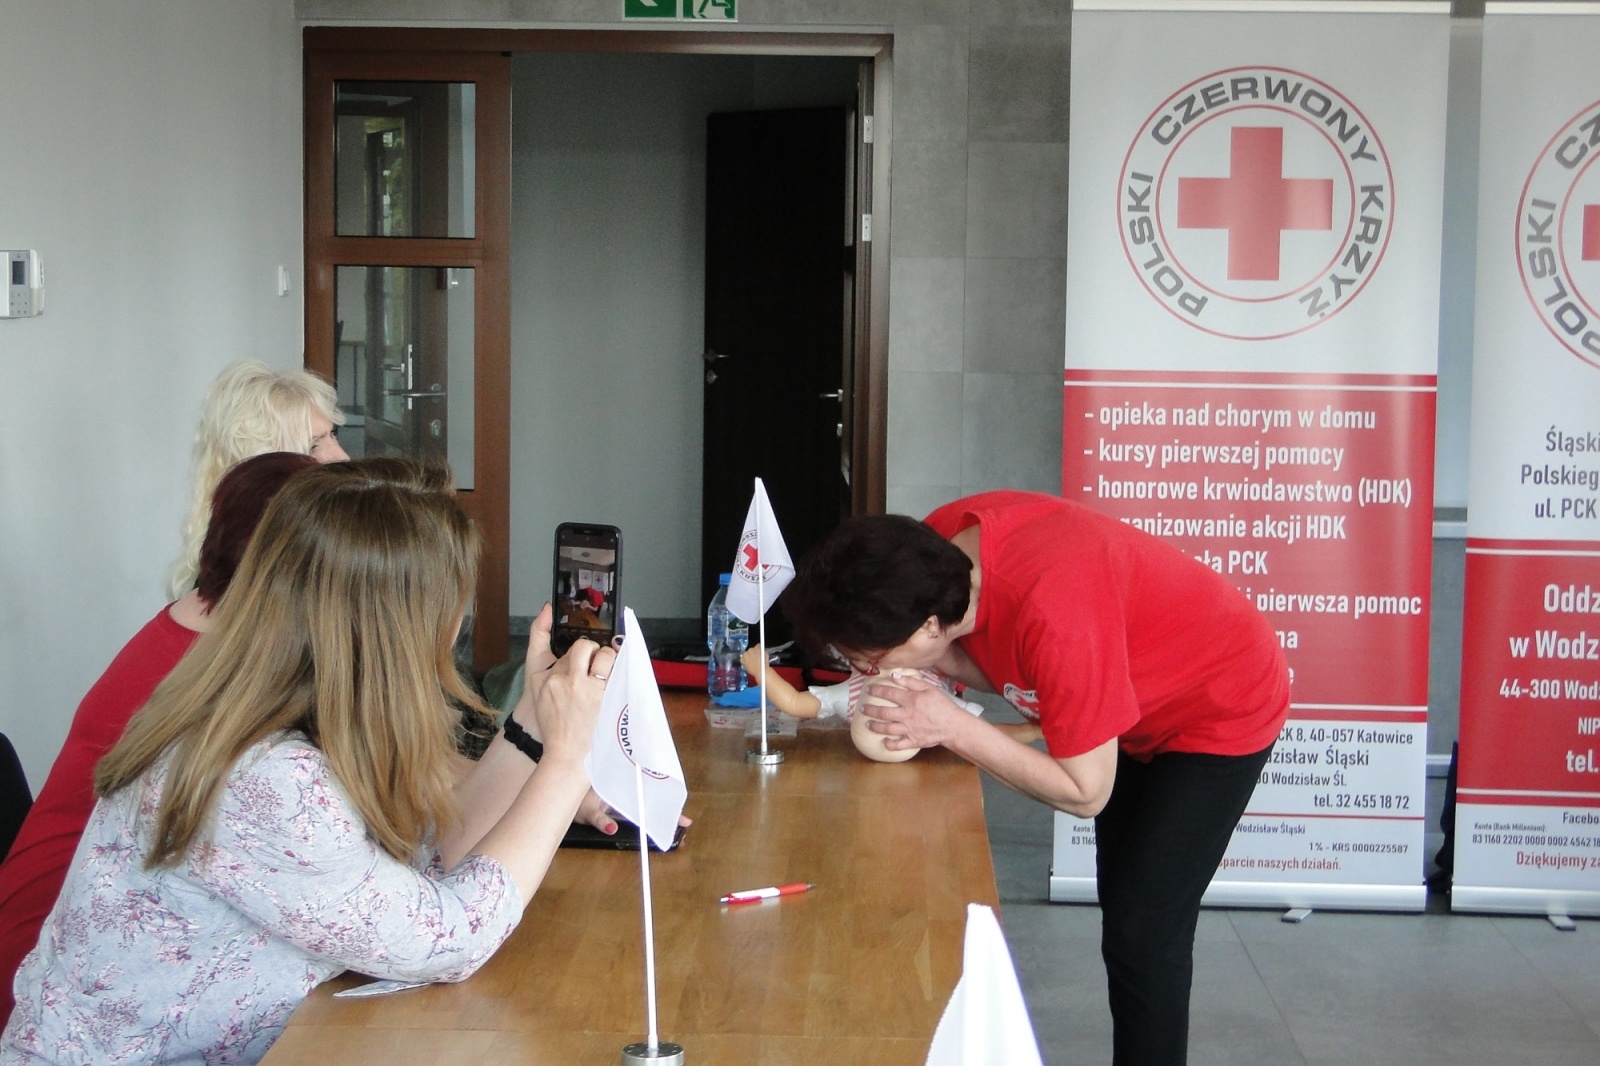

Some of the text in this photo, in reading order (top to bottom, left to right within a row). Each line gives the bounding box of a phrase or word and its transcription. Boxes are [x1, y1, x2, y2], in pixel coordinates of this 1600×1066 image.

[1152, 76, 1378, 163] CZERWONY
[1128, 172, 1208, 318] POLSKI
[1099, 402, 1167, 430] opieka
[1172, 403, 1210, 428] nad
[1214, 403, 1292, 433] chorym
[1297, 408, 1315, 429] w
[1319, 405, 1376, 430] domu
[1098, 438, 1156, 468] kursy
[1161, 440, 1261, 470] pierwszej
[1265, 444, 1345, 471] pomocy
[1520, 464, 1599, 491] Polskieg
[1098, 475, 1198, 500] honorowe
[1203, 477, 1353, 503] krwiodawstwo
[1358, 477, 1412, 508] (HDK)
[1534, 498, 1598, 519] ul. PCK
[1252, 514, 1301, 544] akcji
[1306, 516, 1347, 540] HDK
[1228, 550, 1269, 575] PCK
[1256, 587, 1349, 614] pierwsza
[1354, 594, 1422, 619] pomoc
[1508, 629, 1600, 660] w Wodz
[1499, 678, 1600, 701] 44-300 Wod
[1309, 728, 1354, 743] 40-057
[1357, 729, 1413, 744] Katowice
[1325, 745, 1369, 769] Śląski
[1566, 749, 1599, 773] tel.
[1272, 772, 1330, 786] Wodzisław
[1314, 794, 1410, 809] tel. 32 455 18 72
[1235, 822, 1306, 836] Wodzisław Śląski
[1484, 834, 1501, 844] 1160
[1503, 835, 1523, 845] 2202
[1525, 835, 1545, 845] 0000
[1547, 836, 1568, 846] 0002
[1570, 837, 1591, 847] 4542
[1332, 842, 1350, 852] KRS
[1258, 857, 1299, 871] naszych
[1516, 851, 1588, 871] Dziękujemy
